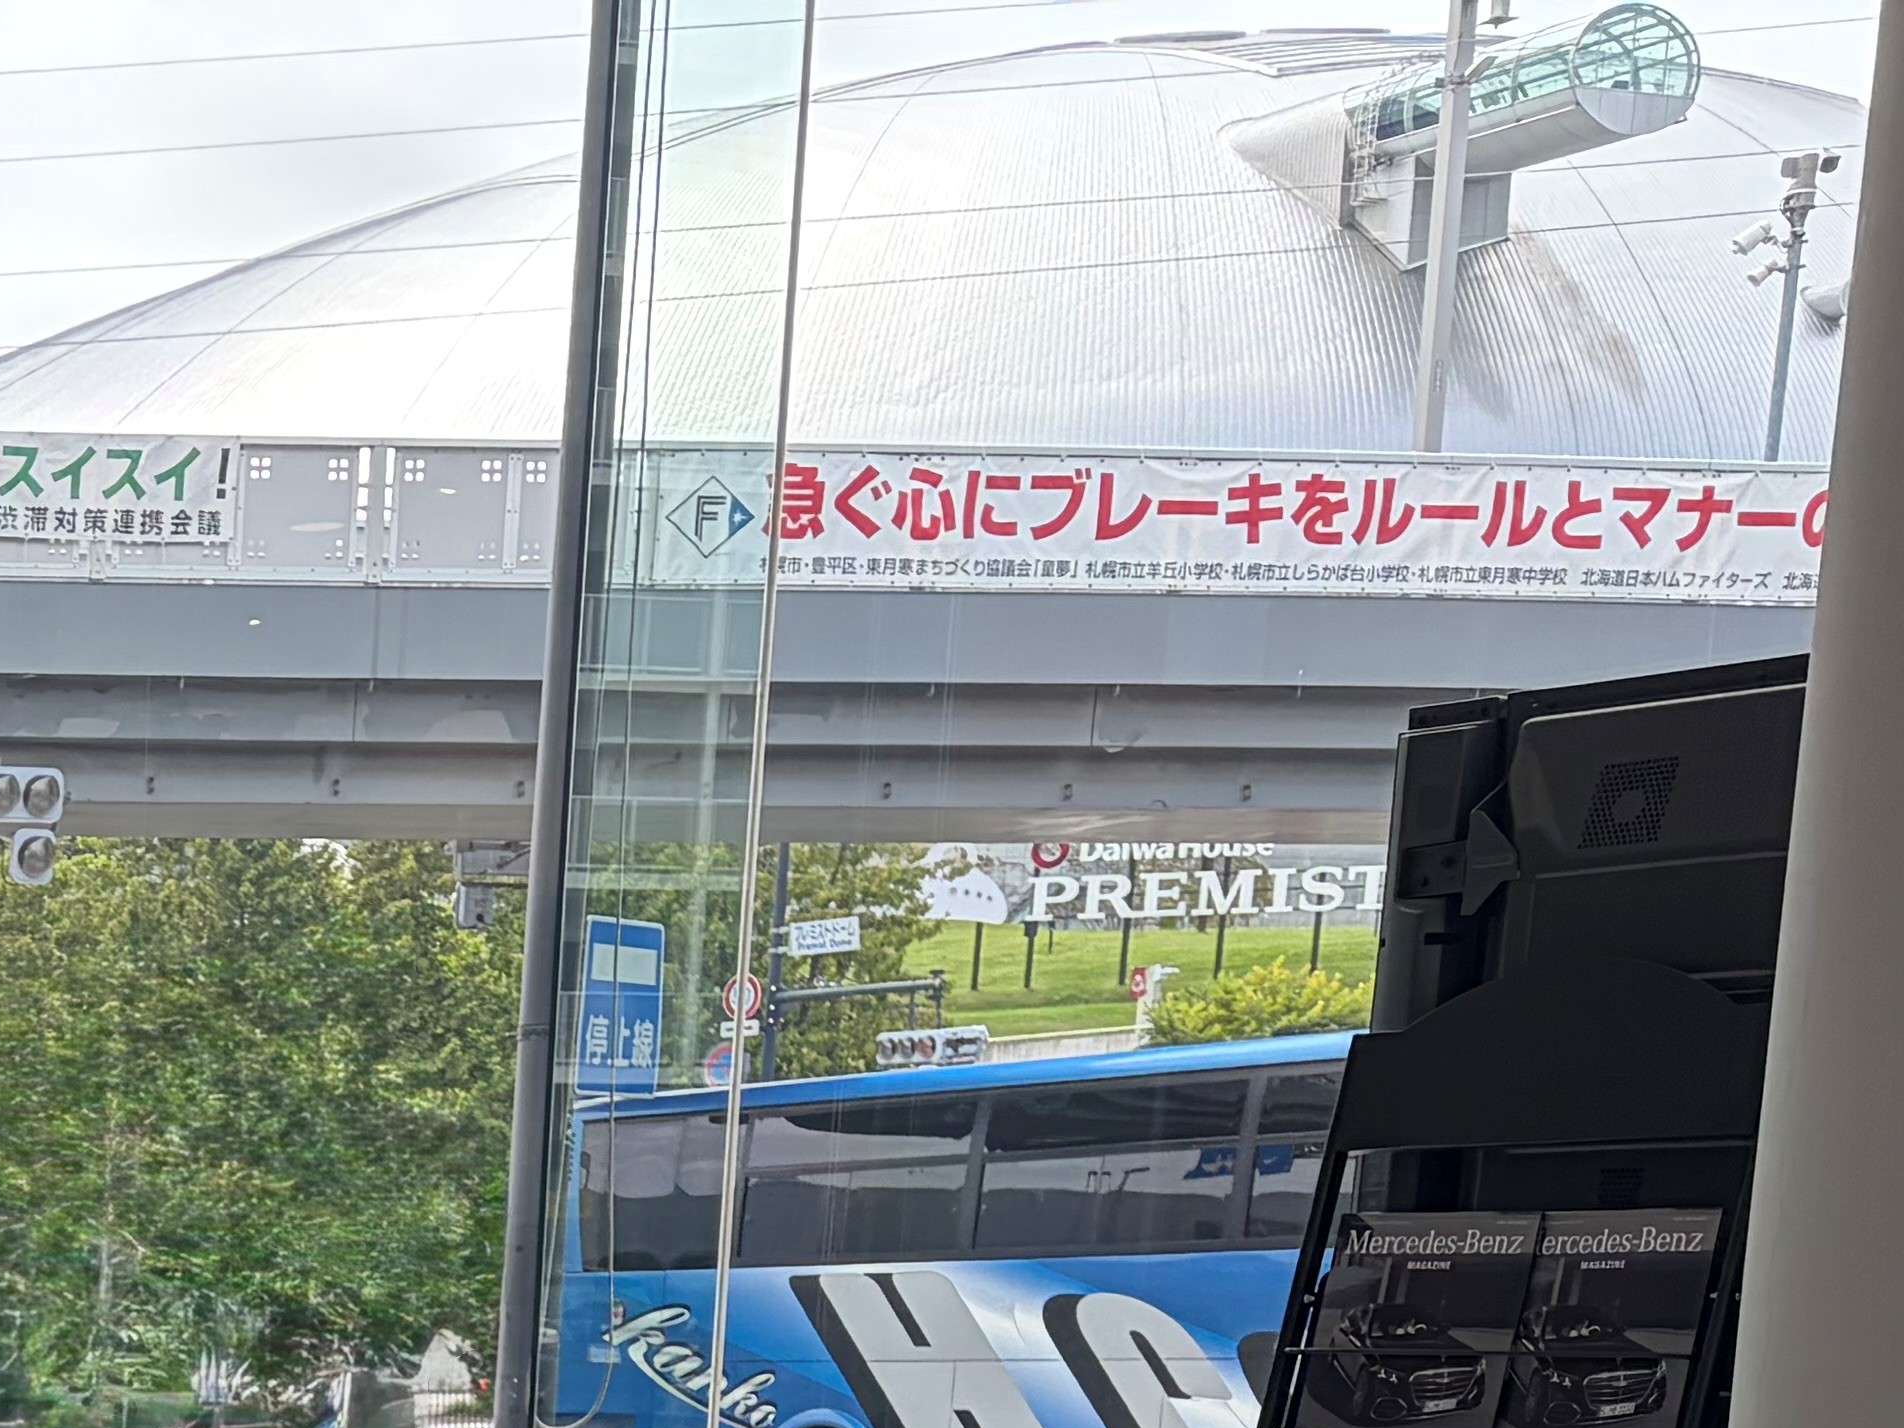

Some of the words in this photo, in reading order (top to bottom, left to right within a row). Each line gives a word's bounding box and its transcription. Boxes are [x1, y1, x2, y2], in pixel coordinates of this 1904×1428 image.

[585, 1014, 654, 1069] 停止線
[1344, 1228, 1525, 1256] Mercedes-Benz
[1537, 1225, 1705, 1257] ercedes-Benz
[1406, 1260, 1452, 1271] MAGAZINE
